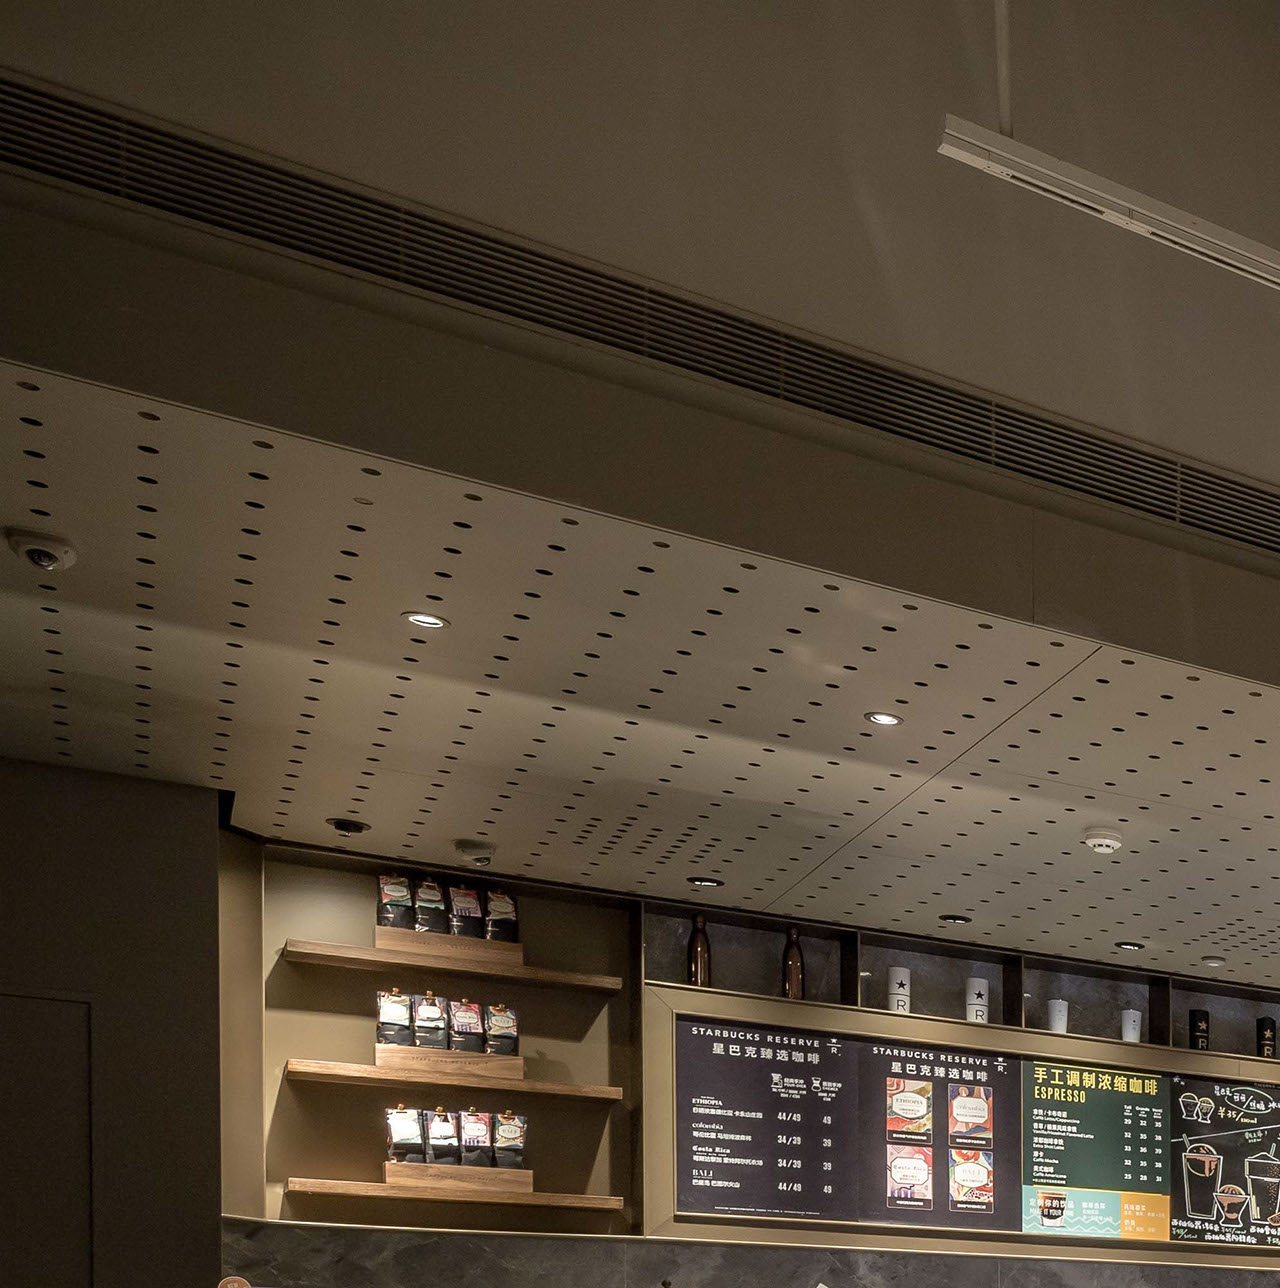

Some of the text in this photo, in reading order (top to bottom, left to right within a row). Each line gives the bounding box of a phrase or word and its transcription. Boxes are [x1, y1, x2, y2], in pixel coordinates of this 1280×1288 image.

[896, 1000, 907, 1011] R
[976, 1010, 985, 1020] R
[692, 1026, 760, 1041] STARBUCKS
[766, 1035, 820, 1048] RESERVE
[872, 1047, 934, 1060] STARBUCKS
[940, 1054, 988, 1066] RESERVE
[1264, 1046, 1273, 1057] R
[1033, 1066, 1158, 1096] 手工调制浓缩咖啡
[1034, 1086, 1086, 1103] ESPRESSO
[692, 1098, 723, 1106] ETHIOPIA
[822, 1116, 832, 1124] 49
[822, 1139, 832, 1148] 39
[822, 1162, 832, 1171] 39
[823, 1185, 832, 1194] 49
